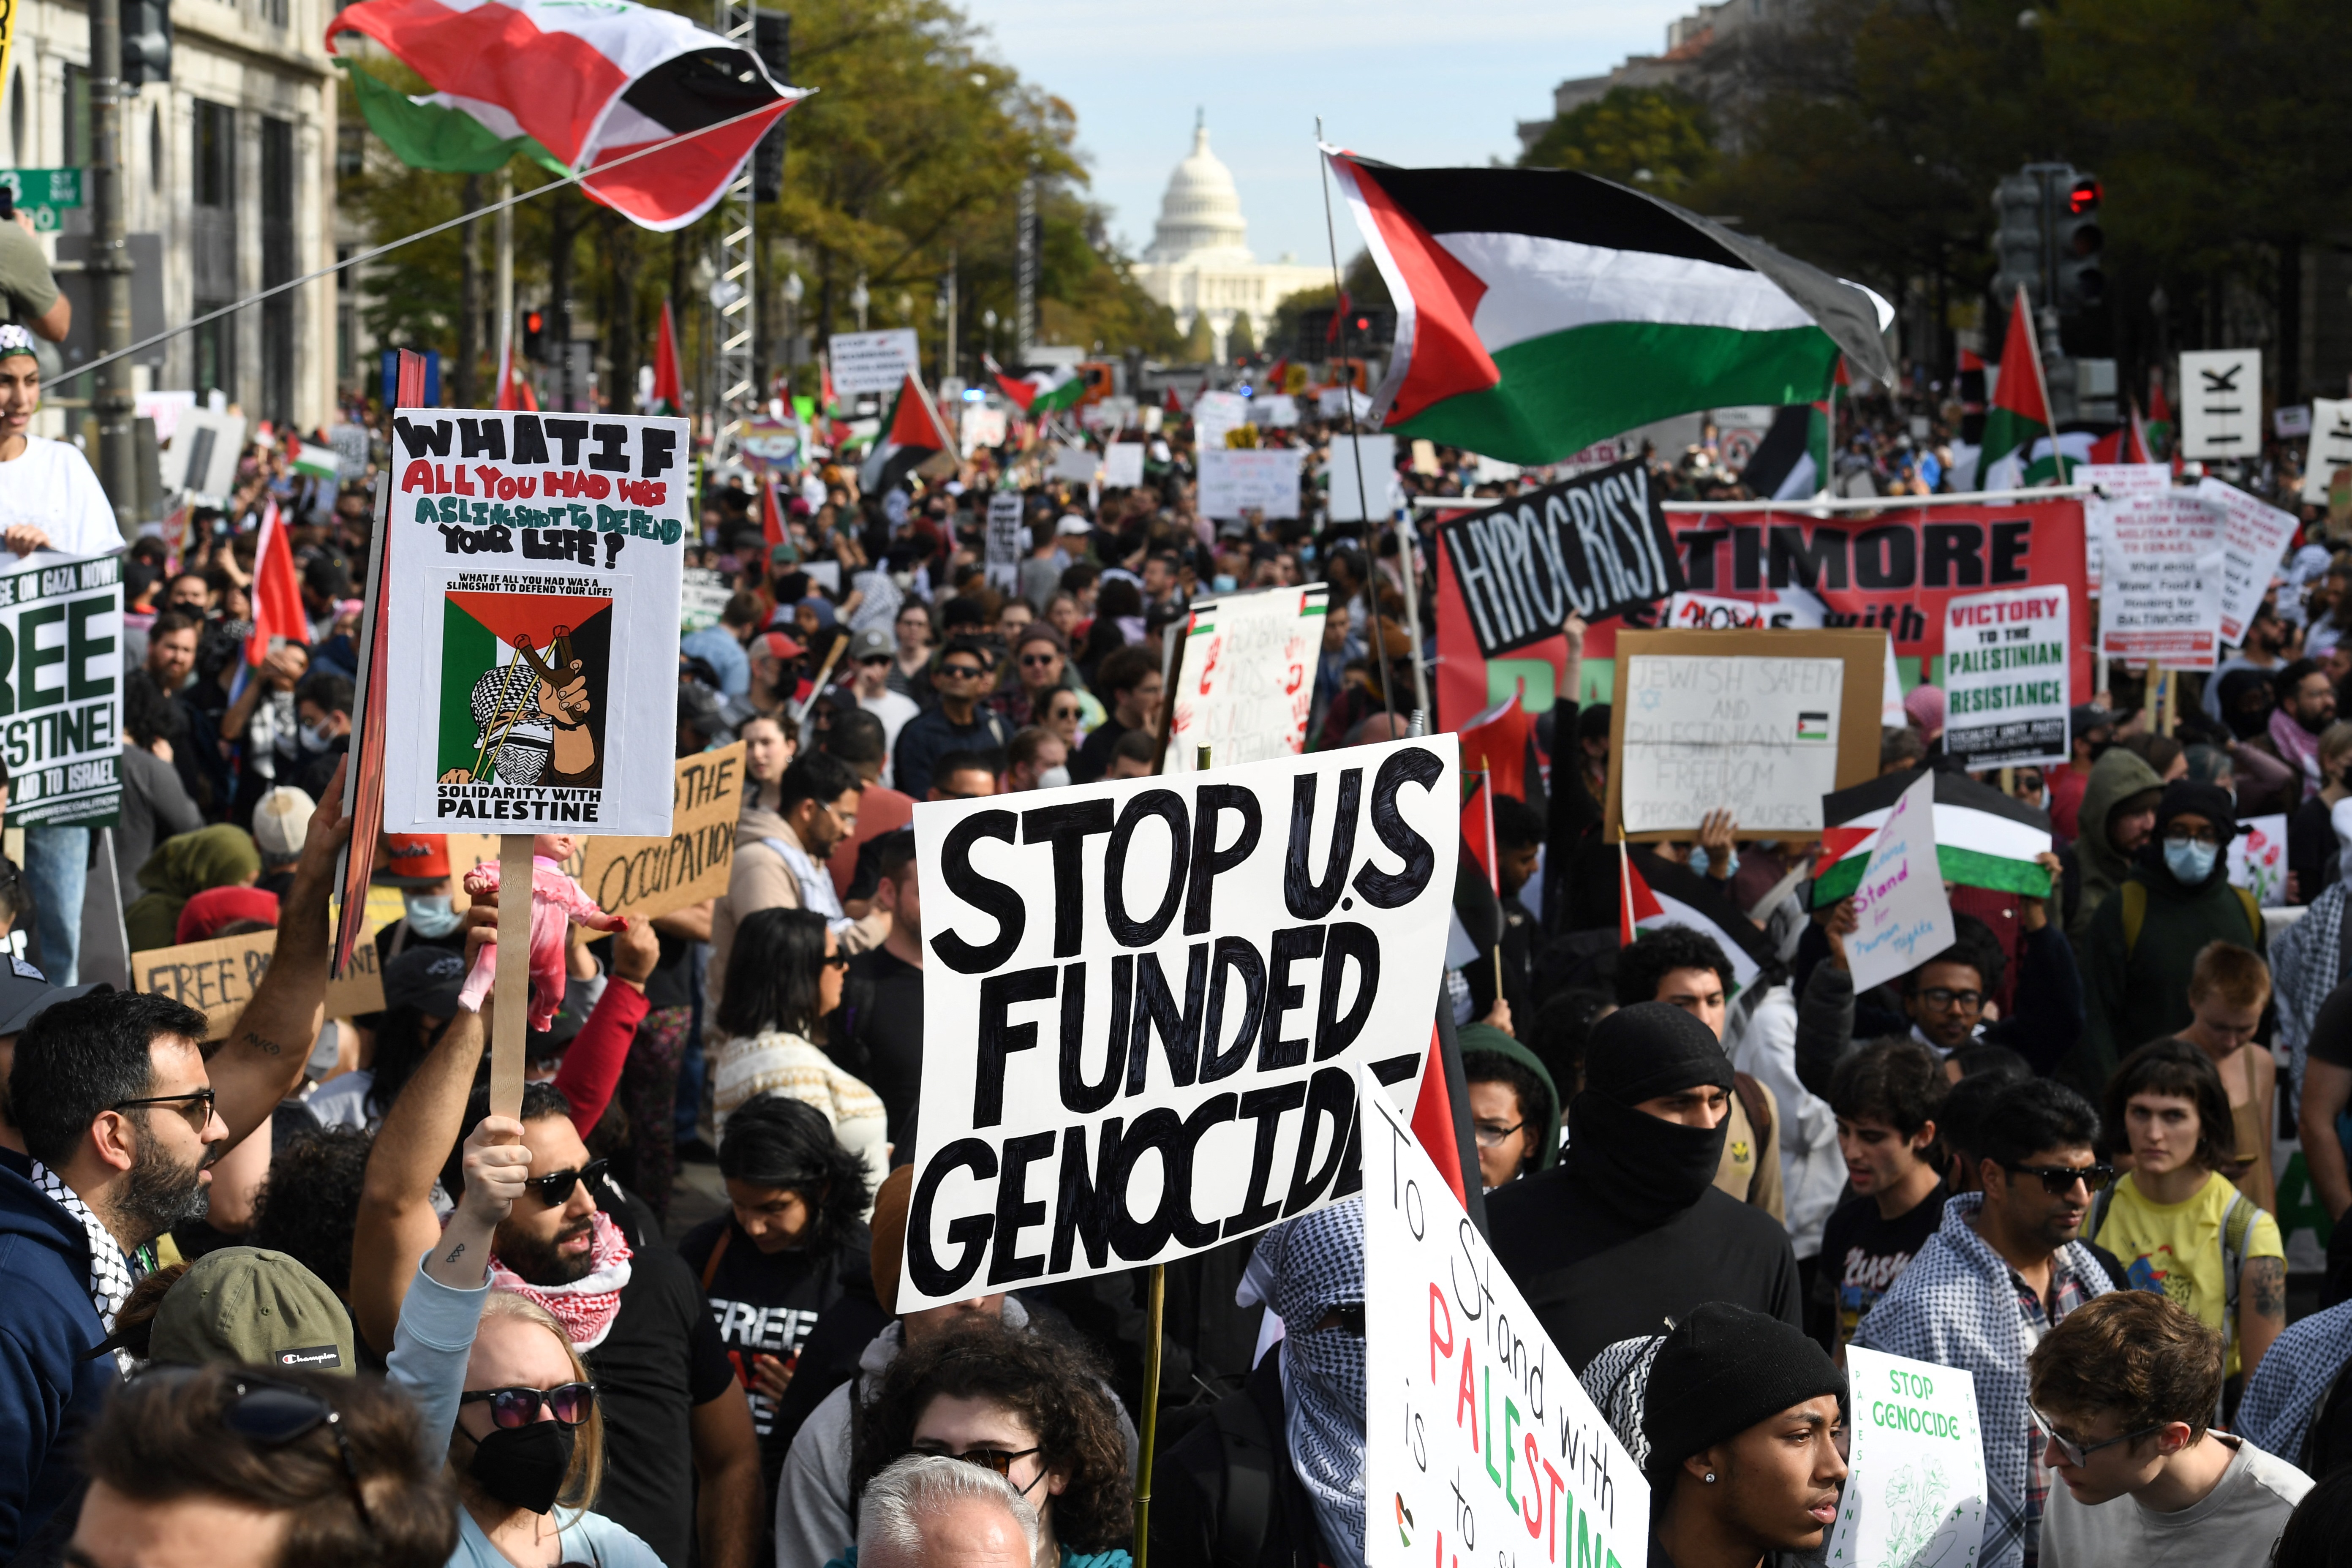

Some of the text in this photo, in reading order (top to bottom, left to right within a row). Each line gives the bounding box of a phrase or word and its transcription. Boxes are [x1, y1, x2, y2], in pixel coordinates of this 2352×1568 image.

[394, 415, 588, 465] WHAT
[588, 424, 676, 478] IF
[402, 459, 667, 507] ALL YOU HAD WAS
[415, 497, 682, 545] A SLINGSHOT TO DEFEND
[438, 524, 514, 554] YOUR
[1447, 466, 1669, 650] HYPOCRISY
[1676, 520, 2032, 592] TIMORE
[19, 572, 38, 602] ON
[42, 565, 77, 596] GAZA
[81, 556, 118, 590] NOW!
[446, 581, 613, 596] SLINGSHOT TO DEFEND YOUR LIFE?
[459, 573, 599, 587] WHAT IF ALL YOU HAD WAS A
[1951, 597, 2059, 628] VICTORY
[1979, 627, 2031, 643] TO THE
[1632, 659, 1745, 696] JEWISH
[1757, 660, 1843, 697] SAFETY
[1949, 642, 2062, 675] PALESTINIAN
[1712, 698, 1750, 719] AND
[1949, 680, 2061, 715] RESISTANCE
[0, 701, 114, 768] STINE!
[1628, 721, 1796, 759] PALESTINIAN
[16, 771, 41, 803] AID
[44, 767, 63, 797] TO
[437, 785, 602, 802] SOLIDARITY WITH
[682, 758, 736, 812] THE
[1655, 760, 1775, 792] FREEDOM
[437, 798, 599, 823] PALESTINE
[599, 821, 736, 915] OCCUPATION
[930, 746, 1444, 975] STOP U.S
[148, 958, 245, 1010] FREE
[973, 922, 1380, 1129] FUNDED
[282, 1353, 337, 1364] Champion
[1451, 1218, 1614, 1529] Stand with
[1889, 1369, 1933, 1400] STOP
[1429, 1282, 1625, 1568] PALESTIN
[1872, 1401, 1960, 1440] GENOCIDE
[1404, 1377, 1474, 1552] is to
[1832, 1370, 1863, 1568] PALESTINIA
